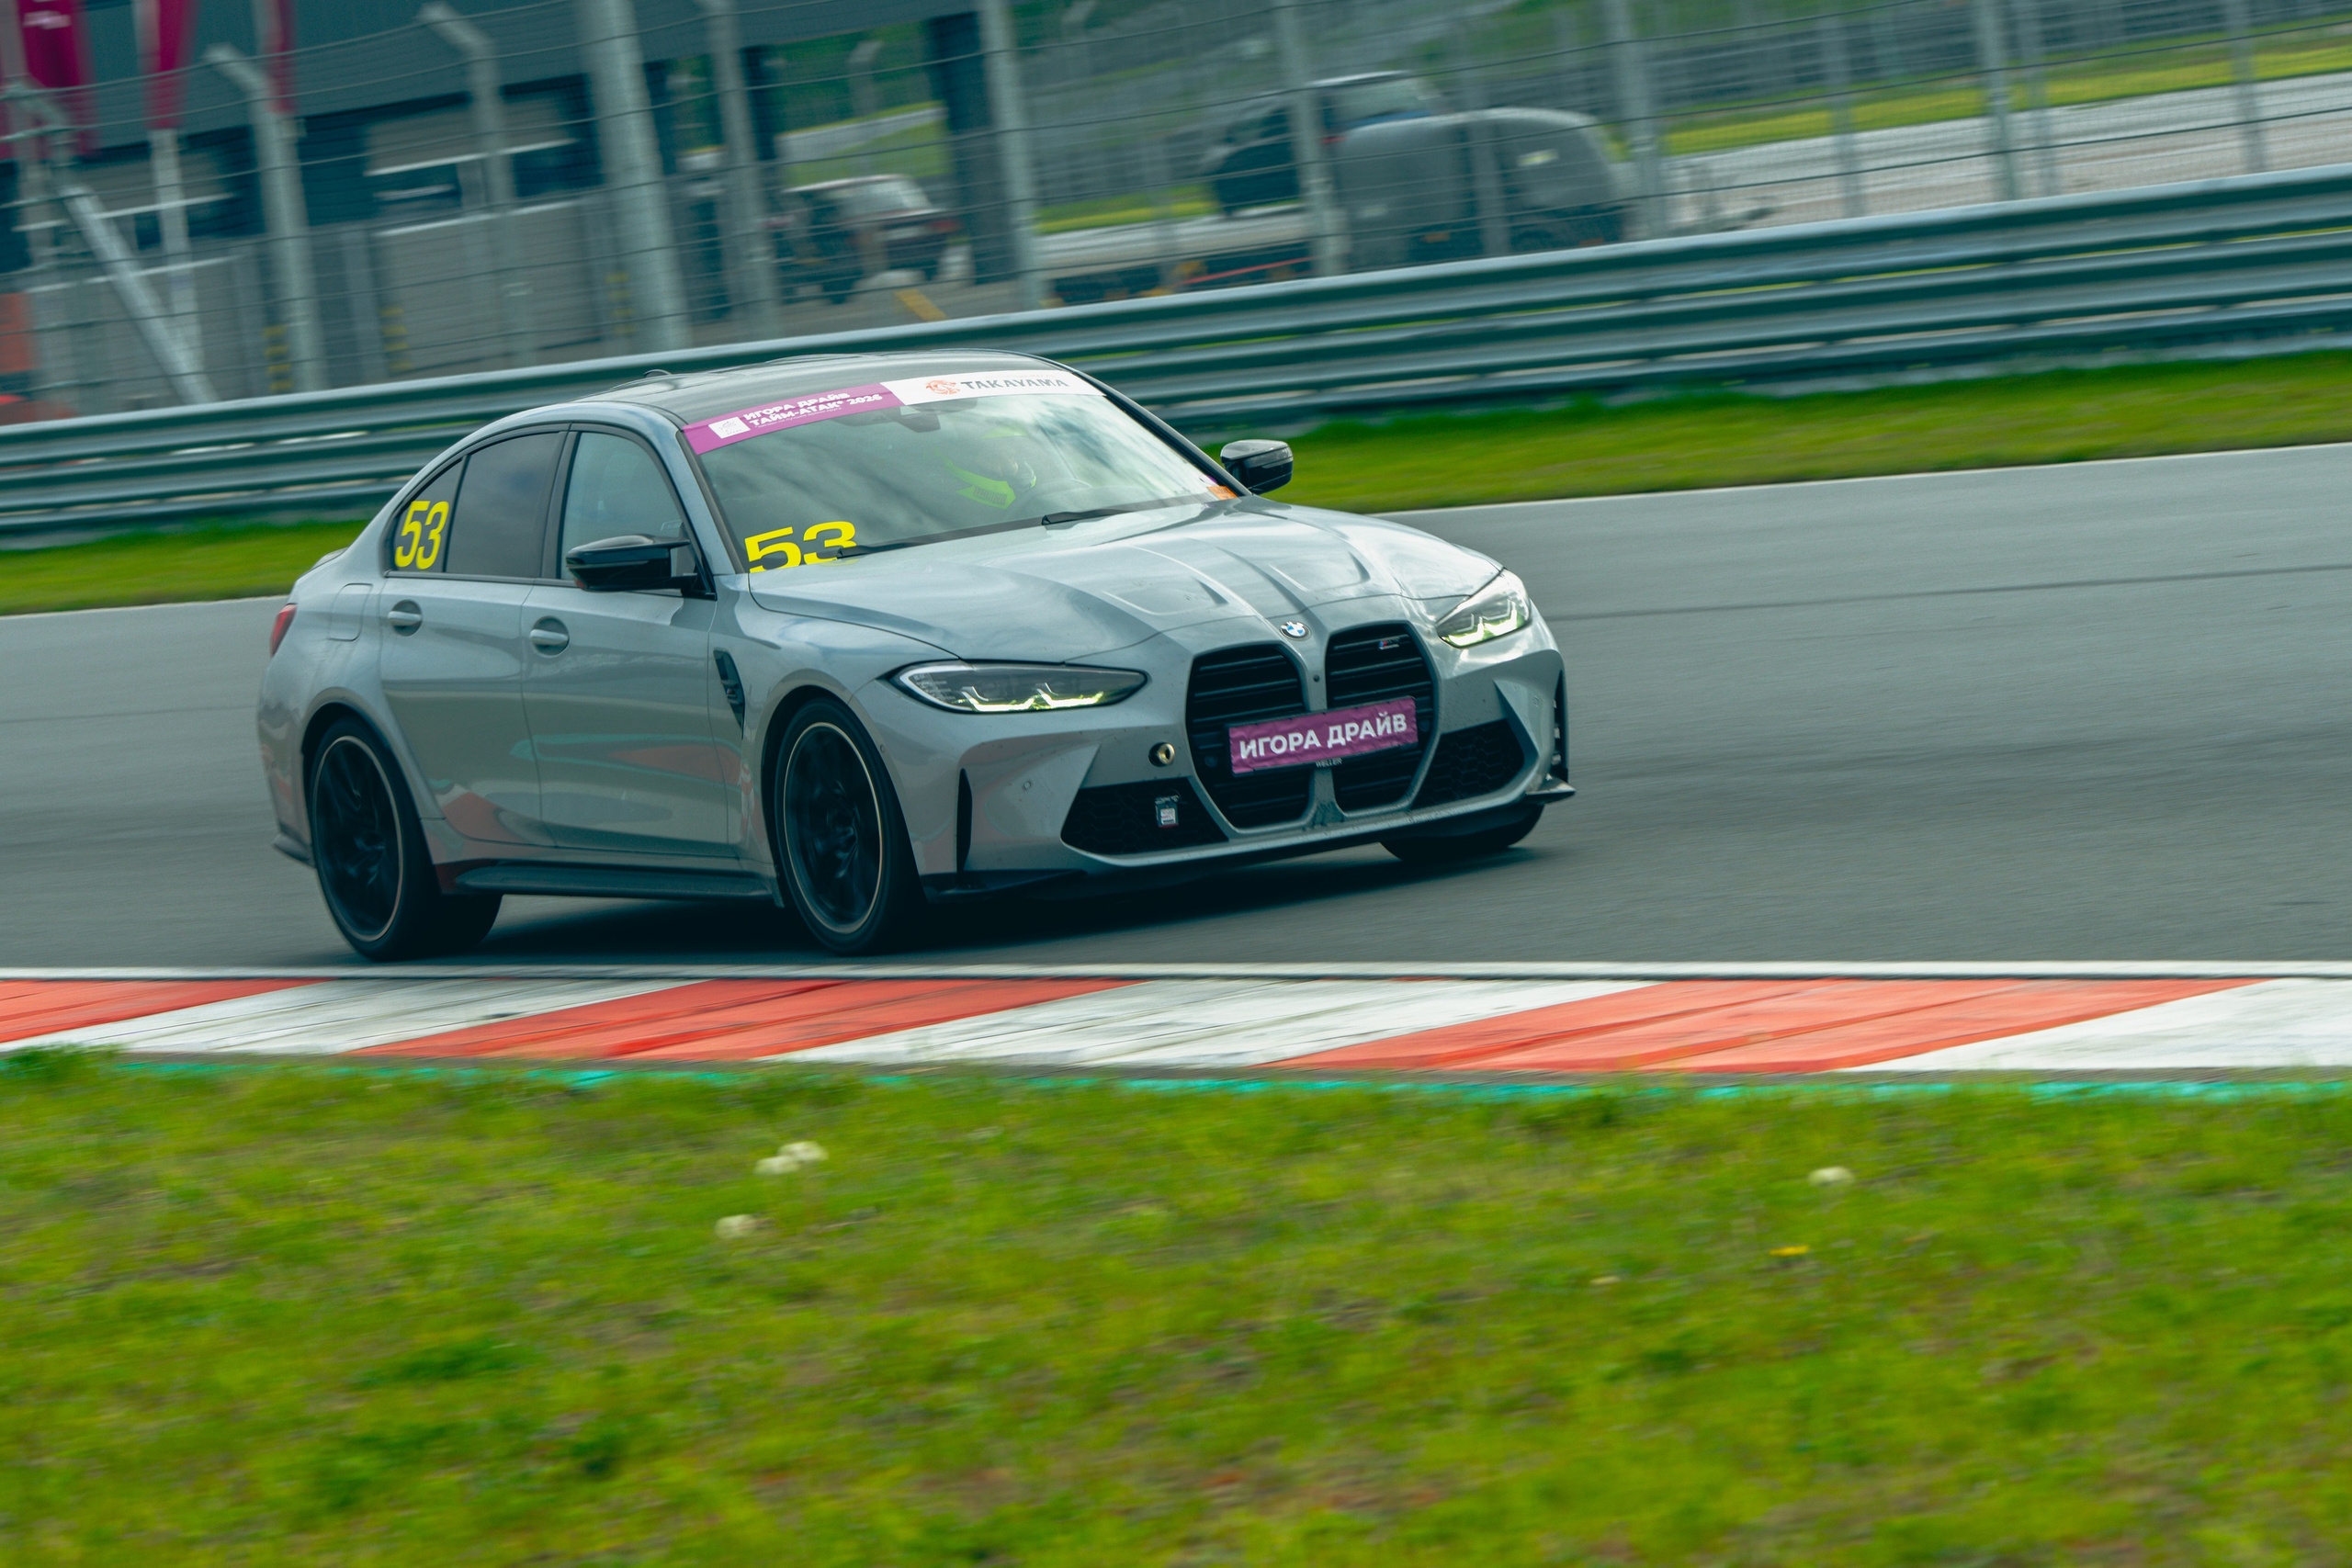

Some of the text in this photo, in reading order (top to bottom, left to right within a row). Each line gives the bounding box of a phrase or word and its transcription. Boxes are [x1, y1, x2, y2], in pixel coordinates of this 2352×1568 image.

[742, 404, 796, 420] ИГОРА
[797, 393, 850, 408] ДРАЙВ
[960, 378, 1069, 389] TAKAYAMA
[395, 501, 449, 570] 53
[744, 521, 857, 573] 53
[1239, 711, 1408, 760] ИГОРА ДРАЙВ
